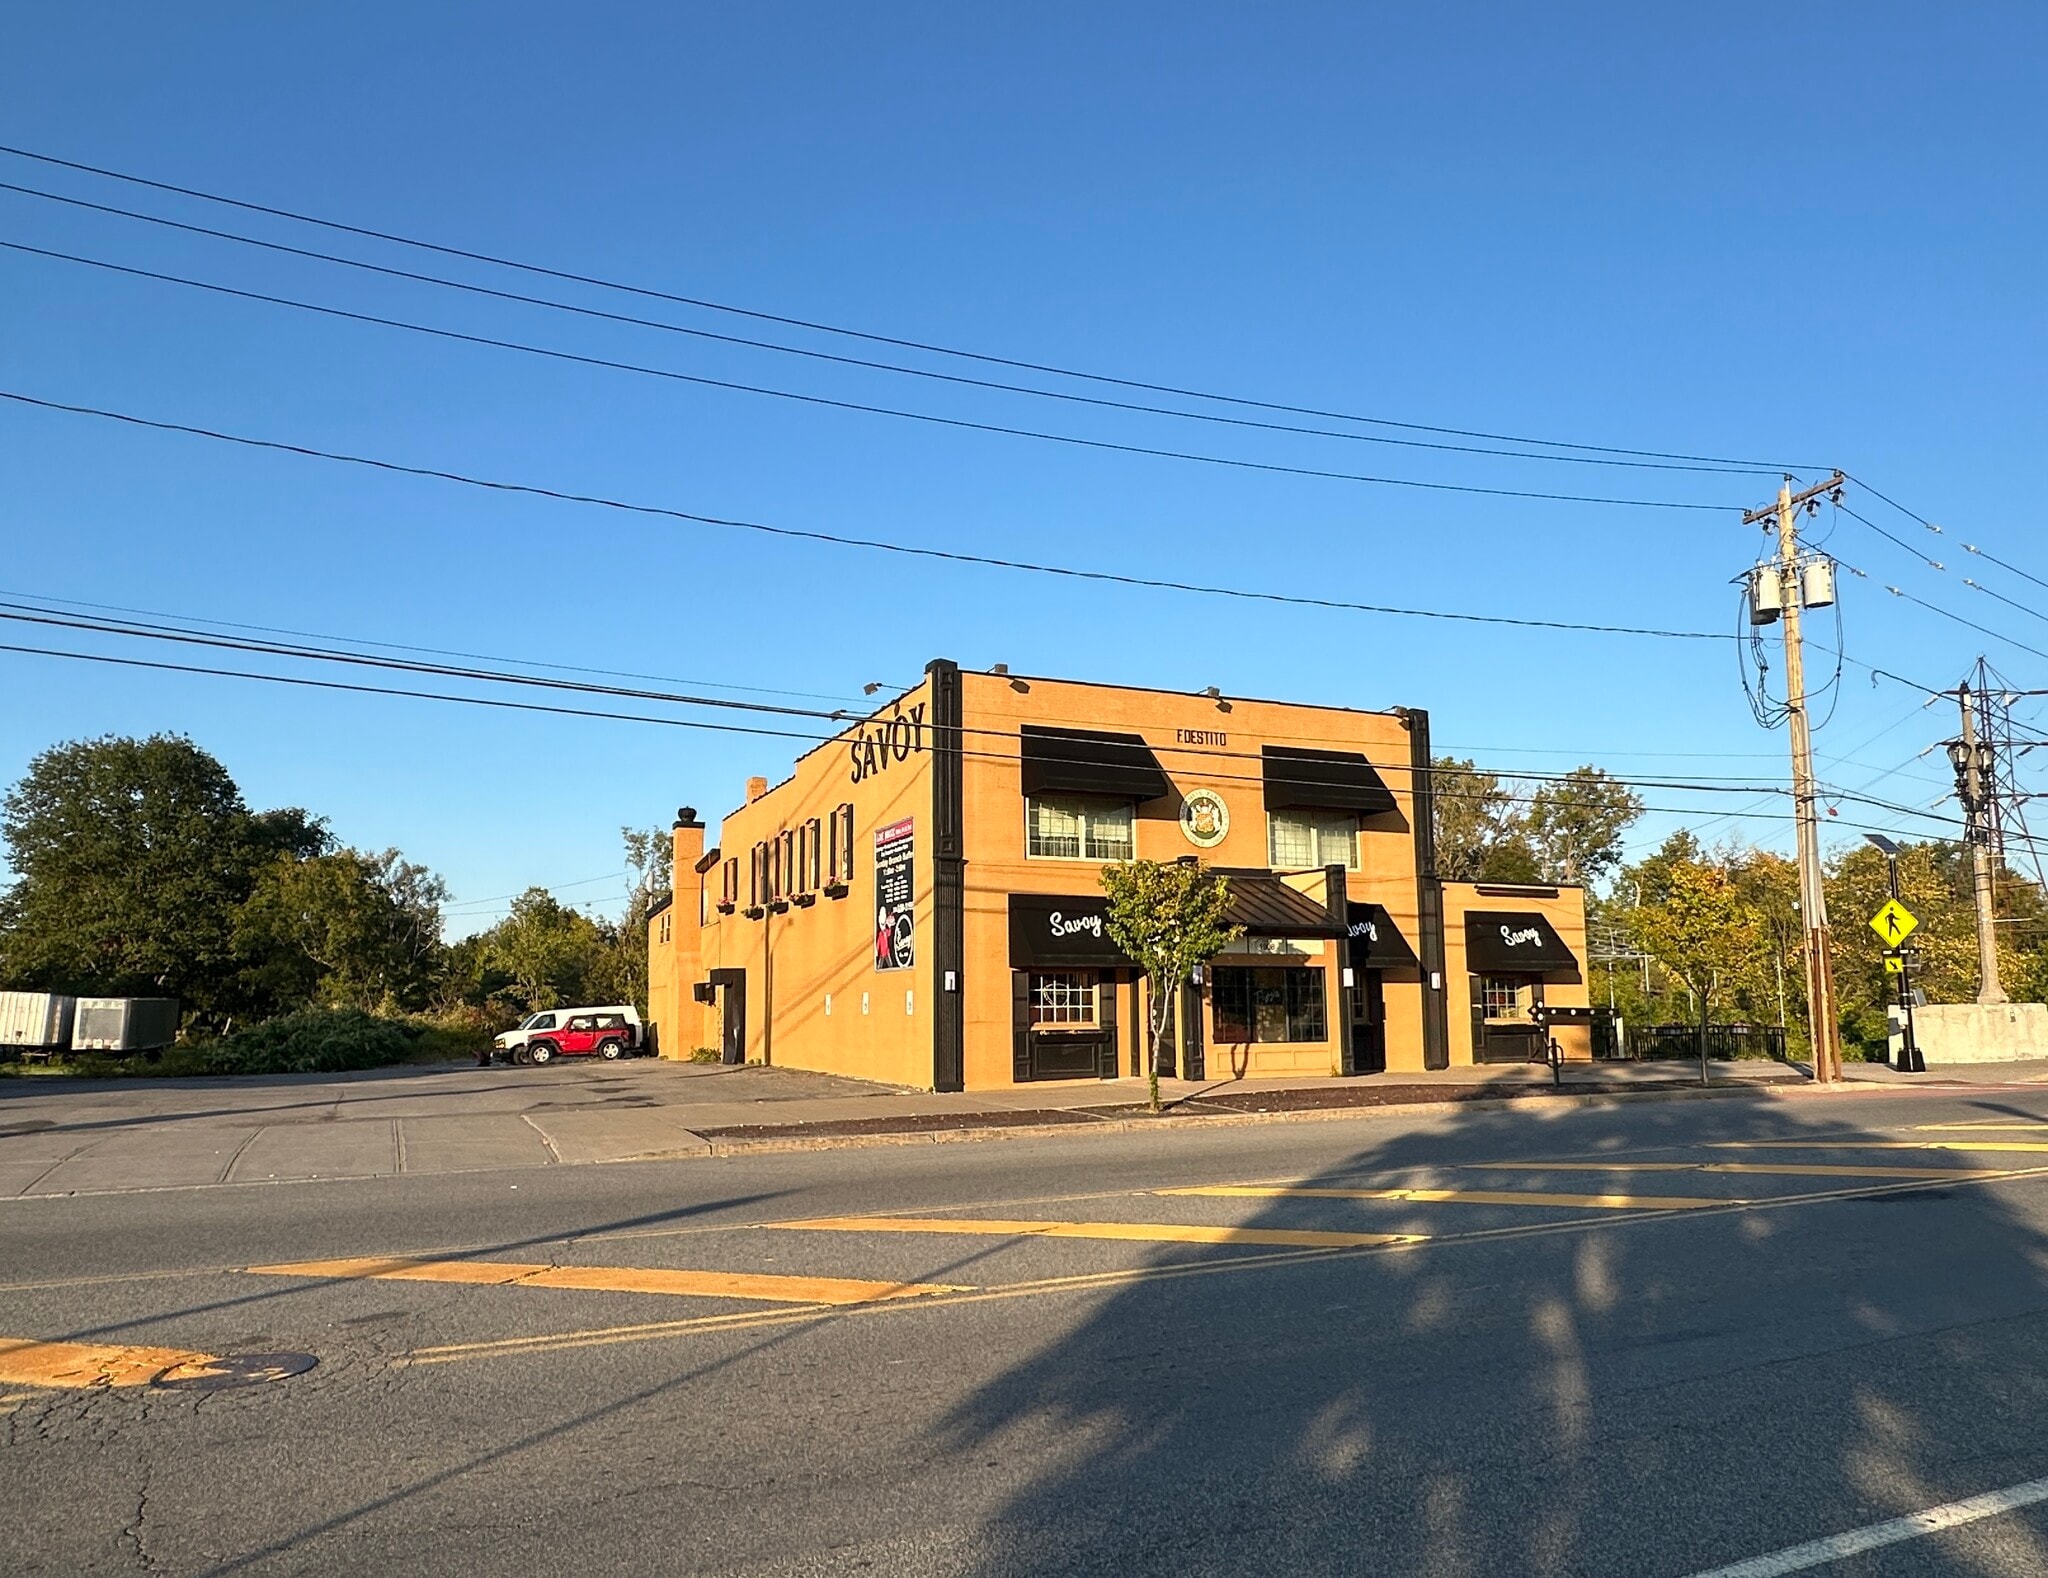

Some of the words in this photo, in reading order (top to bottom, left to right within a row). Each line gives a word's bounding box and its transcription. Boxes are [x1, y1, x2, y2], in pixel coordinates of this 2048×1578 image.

[851, 702, 925, 784] SAVOY
[1050, 912, 1101, 937] Savoy
[1500, 925, 1542, 947] Savoy
